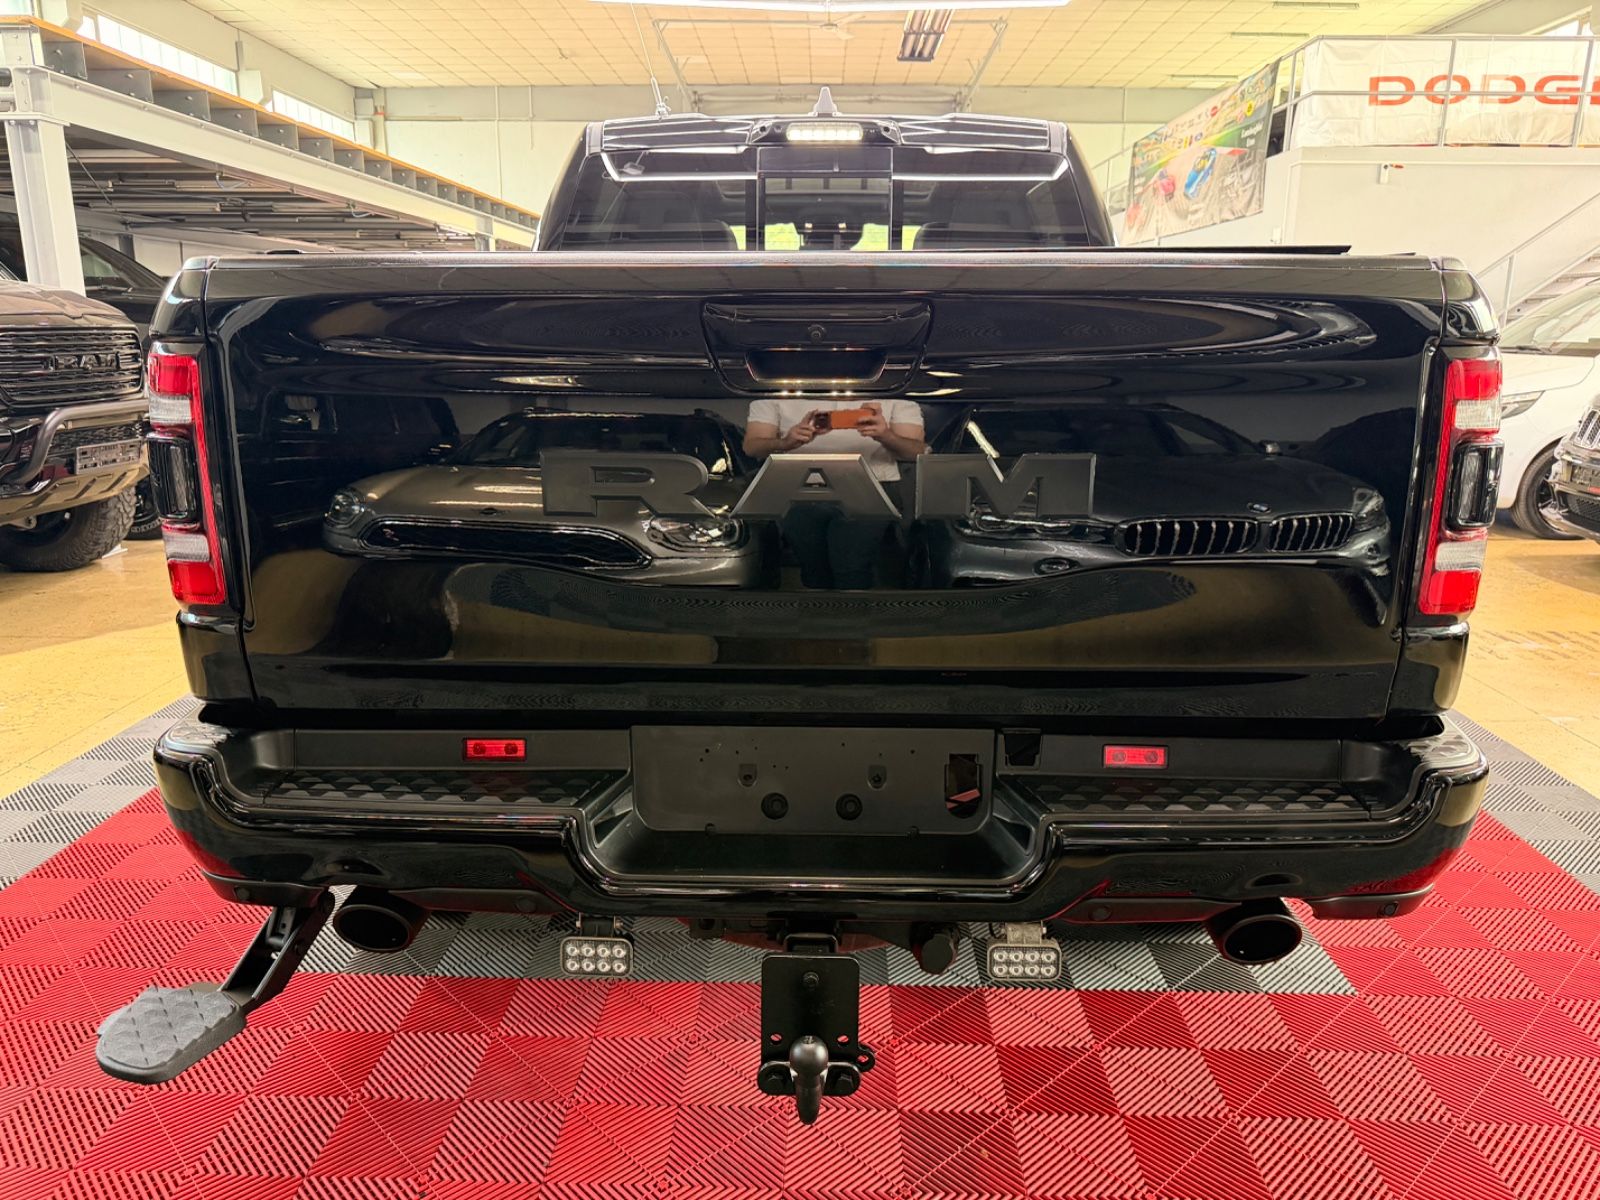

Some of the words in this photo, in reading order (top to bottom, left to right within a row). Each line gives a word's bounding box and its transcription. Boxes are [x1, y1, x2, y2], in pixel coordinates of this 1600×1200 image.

[1368, 74, 1600, 106] DODG
[55, 354, 116, 369] RAM
[540, 453, 1097, 520] RAM
